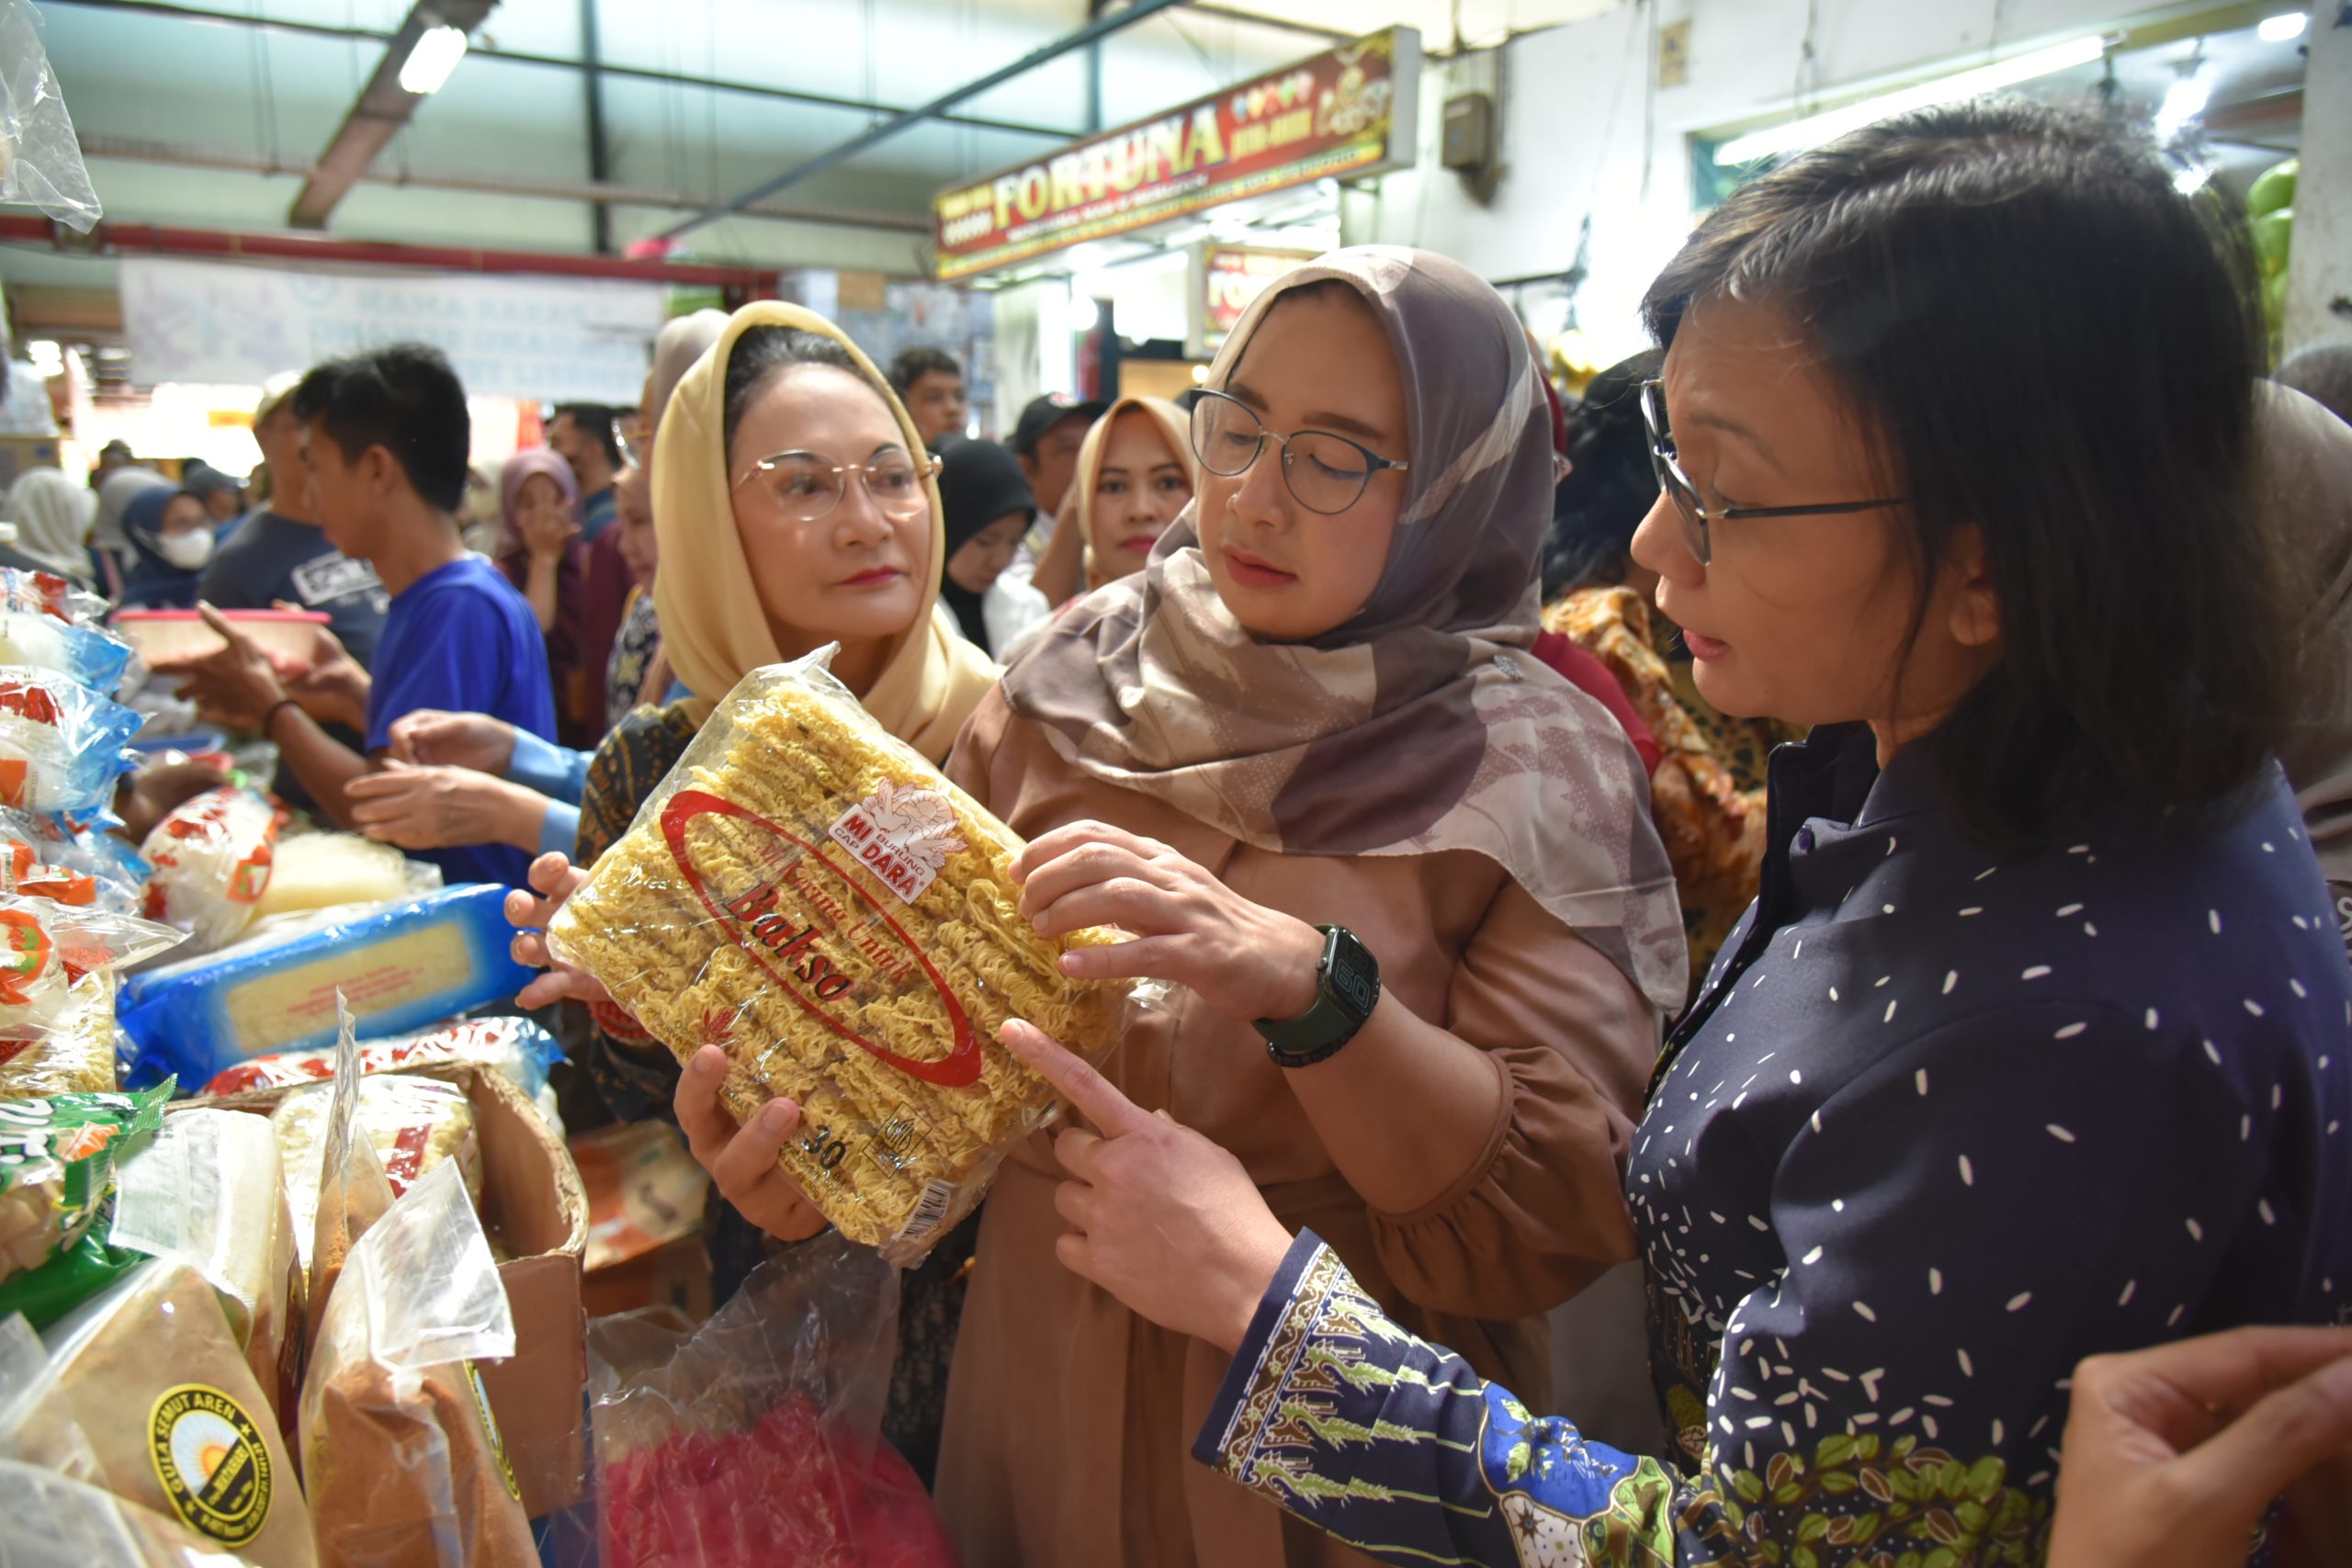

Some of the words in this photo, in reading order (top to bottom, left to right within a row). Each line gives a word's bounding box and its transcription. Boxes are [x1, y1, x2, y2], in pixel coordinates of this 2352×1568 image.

[993, 104, 1227, 230] FORTUNA
[834, 828, 860, 850] CAP
[843, 813, 875, 842] MI
[860, 841, 919, 897] DARA
[876, 833, 925, 876] BURUNG
[721, 880, 854, 1001] Bakso
[778, 858, 849, 930] Kering
[847, 919, 912, 980] Untuk
[801, 1124, 846, 1168] 30
[156, 1393, 191, 1437] SEMUT
[193, 1393, 236, 1420] AREN
[156, 1442, 184, 1494] GULA
